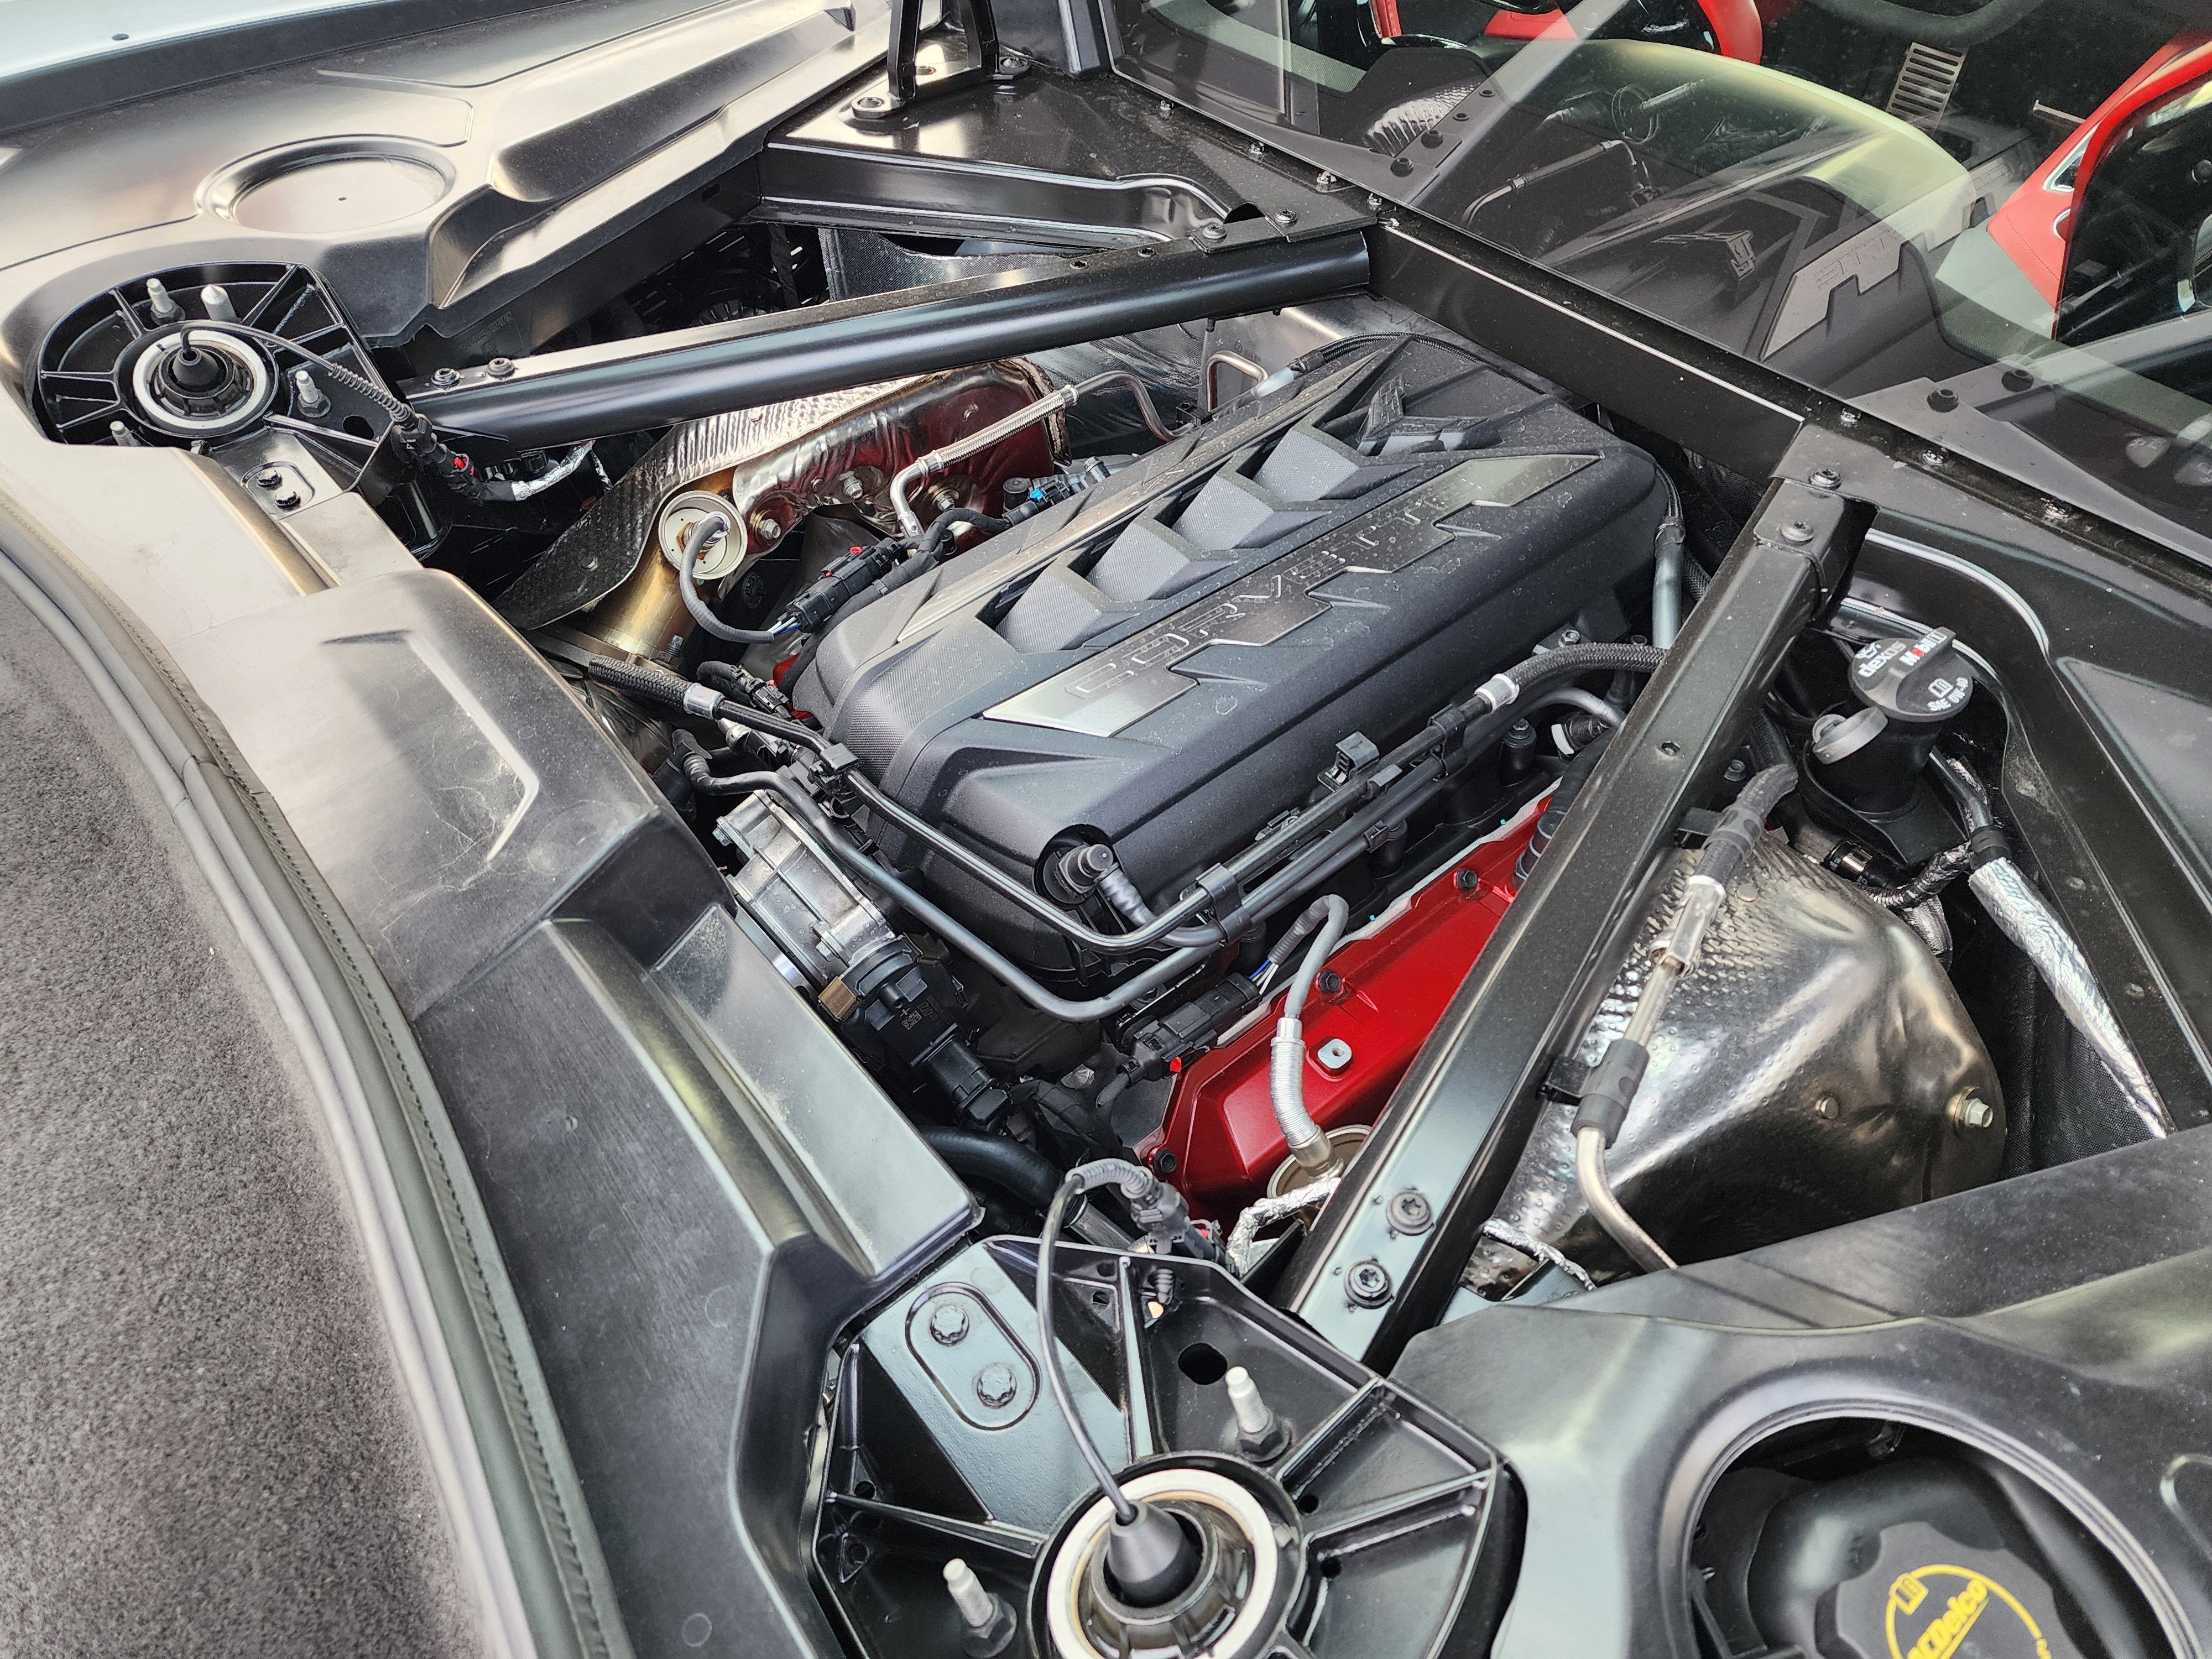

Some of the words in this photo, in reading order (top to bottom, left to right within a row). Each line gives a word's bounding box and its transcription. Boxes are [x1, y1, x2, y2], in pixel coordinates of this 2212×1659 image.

[1065, 478, 1483, 698] CORVETTE
[1858, 640, 1907, 678] dexos
[1927, 698, 1951, 712] SAE
[1948, 676, 1969, 703] 0W-40
